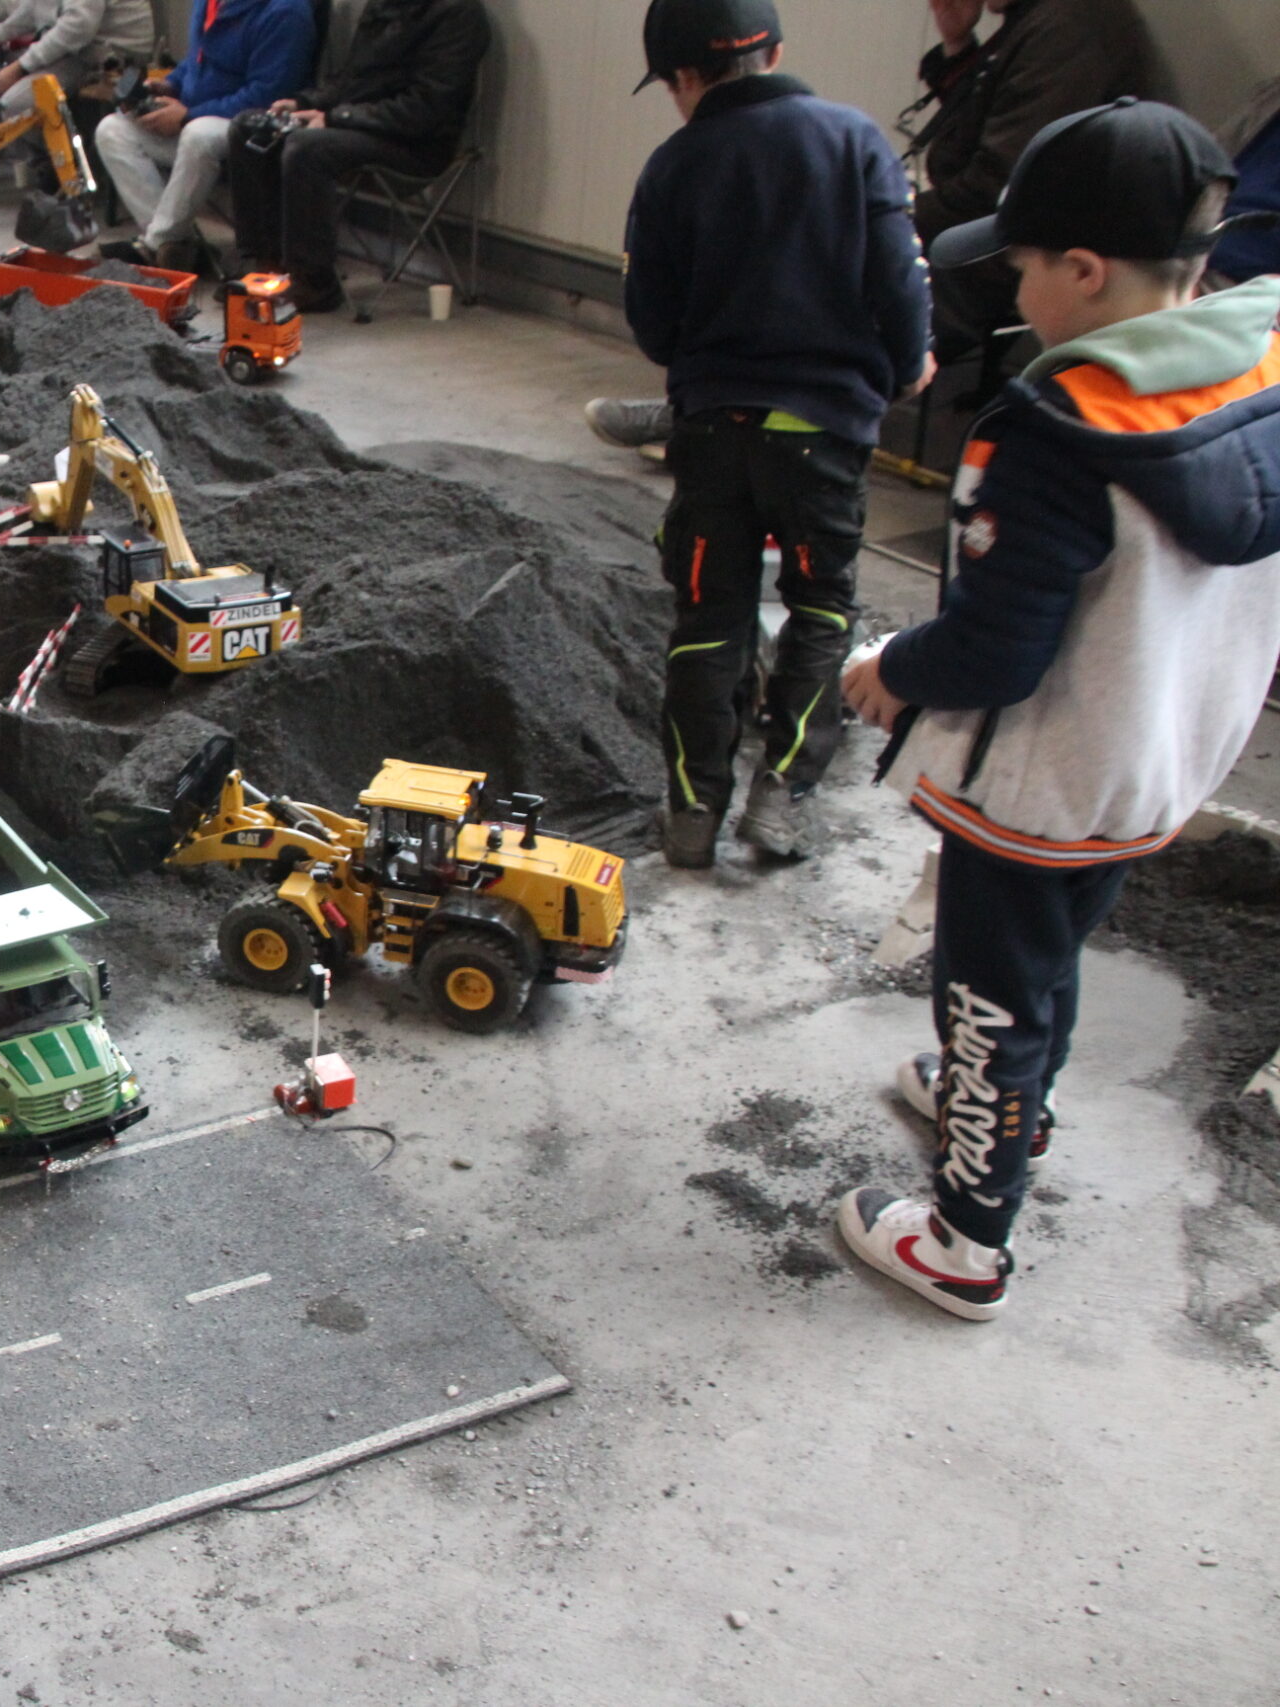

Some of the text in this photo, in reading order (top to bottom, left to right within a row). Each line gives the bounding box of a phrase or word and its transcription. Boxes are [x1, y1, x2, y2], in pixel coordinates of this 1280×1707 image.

[227, 602, 281, 621] ZINDEL
[223, 625, 270, 661] CAT
[236, 831, 261, 847] CAT
[1003, 1090, 1021, 1138] 1982
